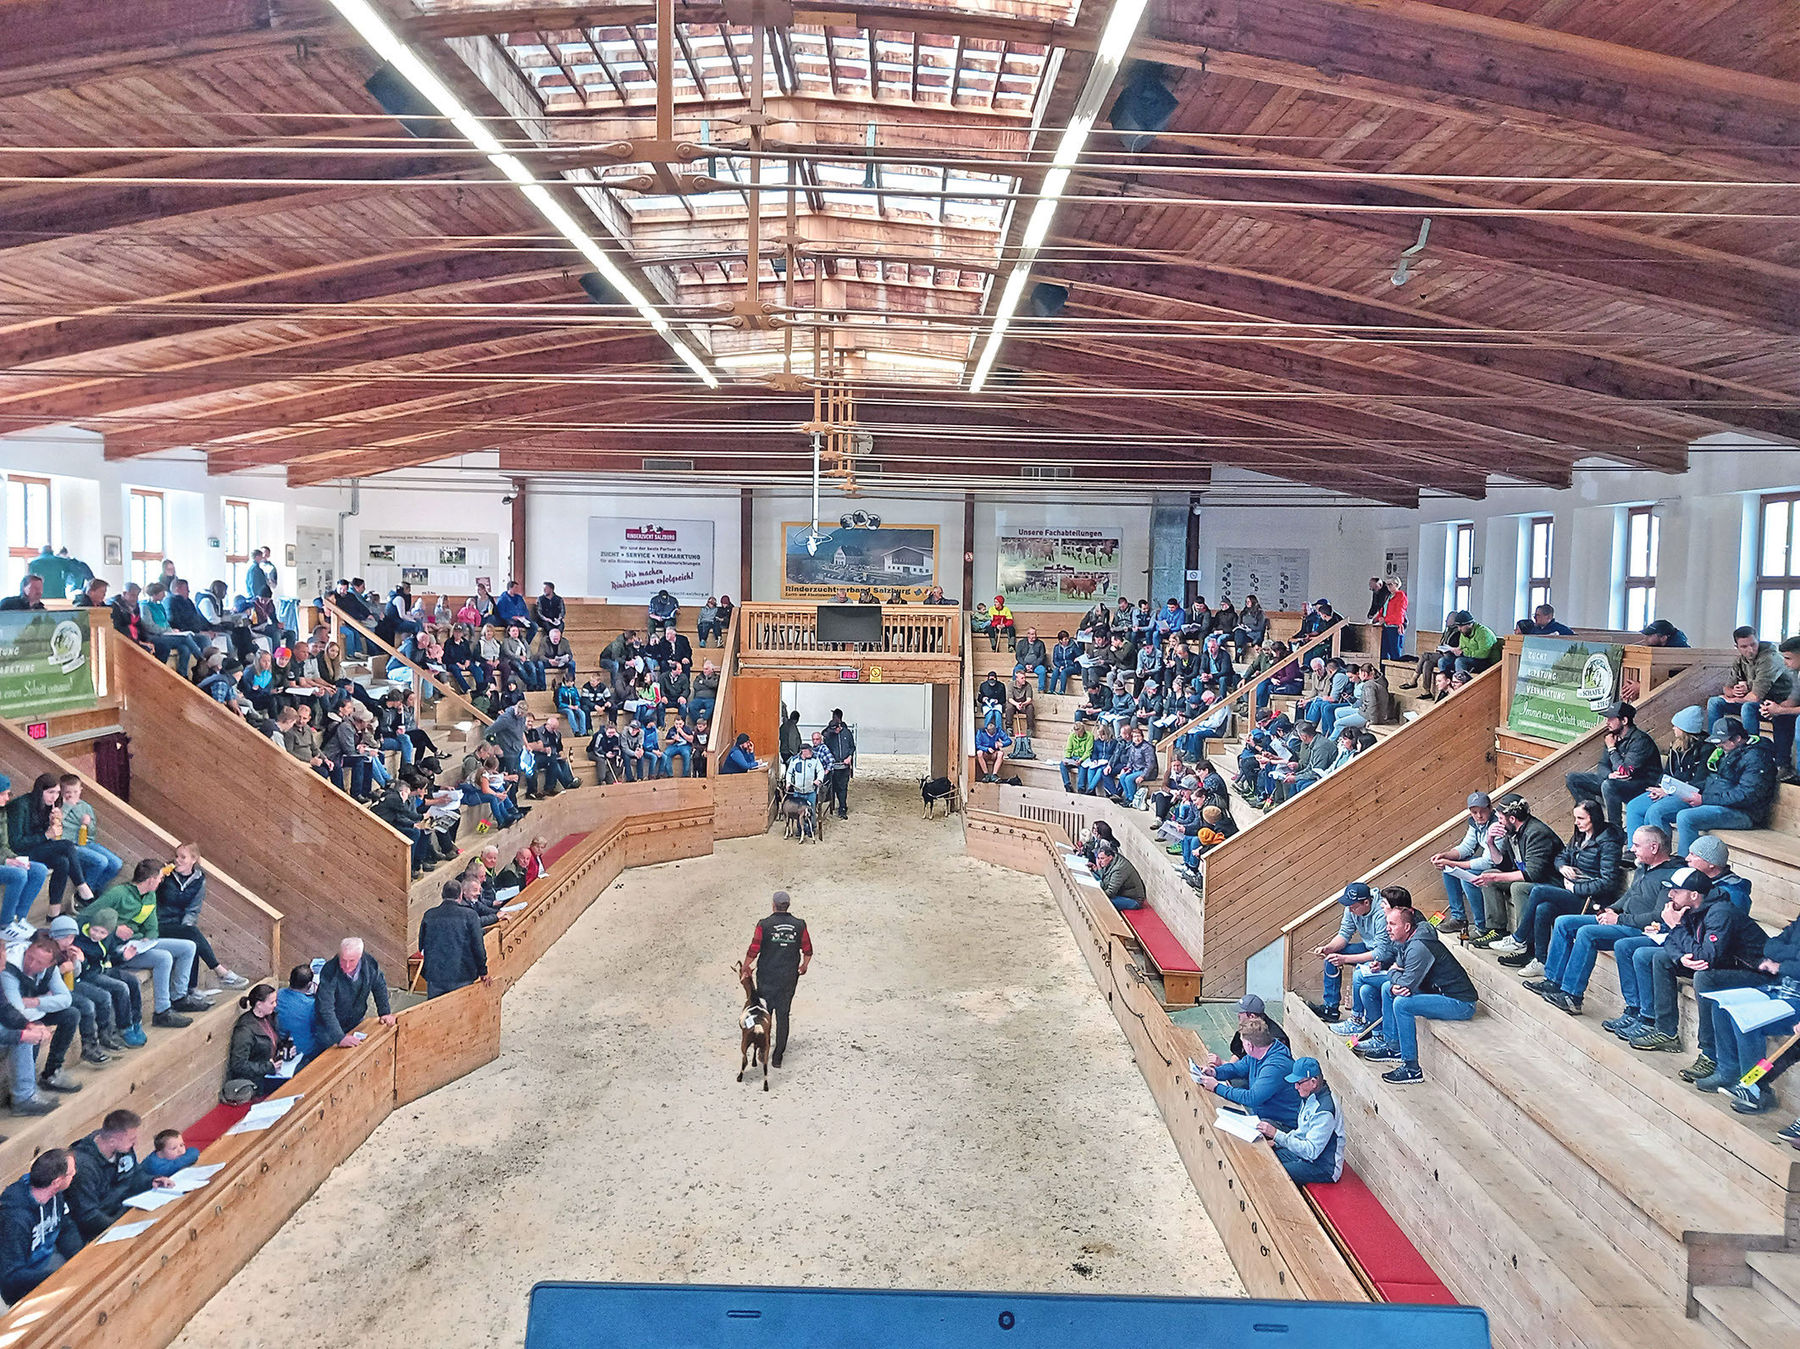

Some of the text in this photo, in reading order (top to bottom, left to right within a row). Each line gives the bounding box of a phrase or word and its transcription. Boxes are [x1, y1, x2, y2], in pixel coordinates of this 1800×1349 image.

[1045, 529, 1102, 537] Fachabteilungen
[625, 568, 663, 579] Wir machen
[611, 572, 694, 590] Rinderbauern erfolgreich!
[873, 586, 911, 594] Salzburg
[1528, 651, 1547, 660] ZUCHT
[24, 680, 46, 697] Schritt
[1526, 685, 1566, 701] VERMARKTUNG
[1583, 688, 1602, 697] SCHAFE
[1519, 701, 1542, 719] Immer
[1556, 708, 1576, 726] Schritt
